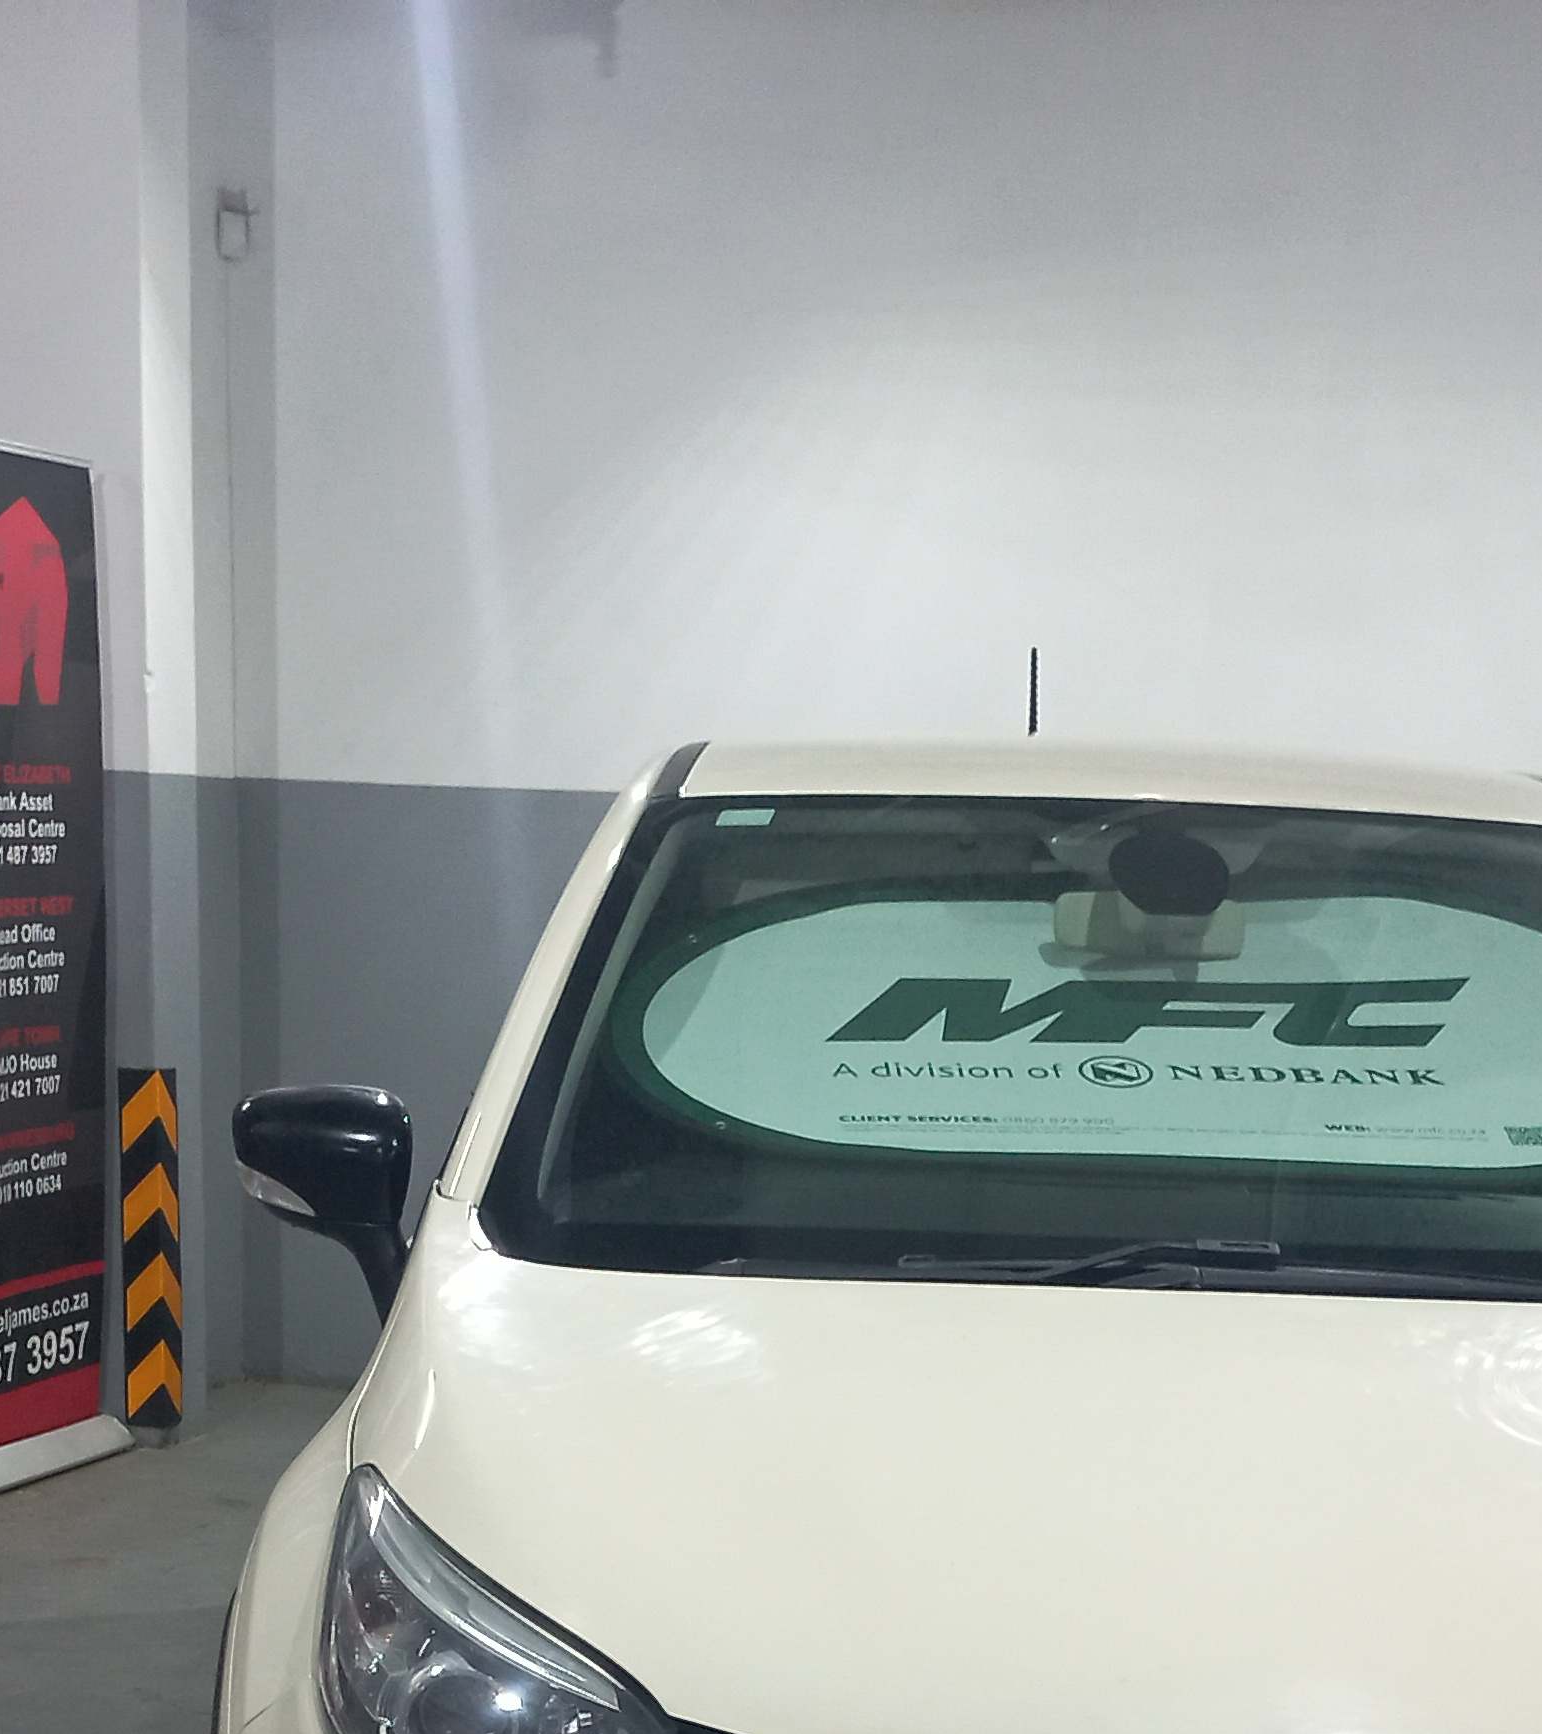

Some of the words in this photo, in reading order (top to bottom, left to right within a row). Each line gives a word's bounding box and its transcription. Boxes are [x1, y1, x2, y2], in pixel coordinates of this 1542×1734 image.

[825, 978, 1469, 1046] MFC
[833, 1063, 857, 1077] A
[871, 1061, 1013, 1079] division
[1027, 1064, 1061, 1079] of
[1167, 1065, 1445, 1086] NEDBANK
[839, 1115, 901, 1123] CLIENT
[27, 1321, 89, 1375] 3957
